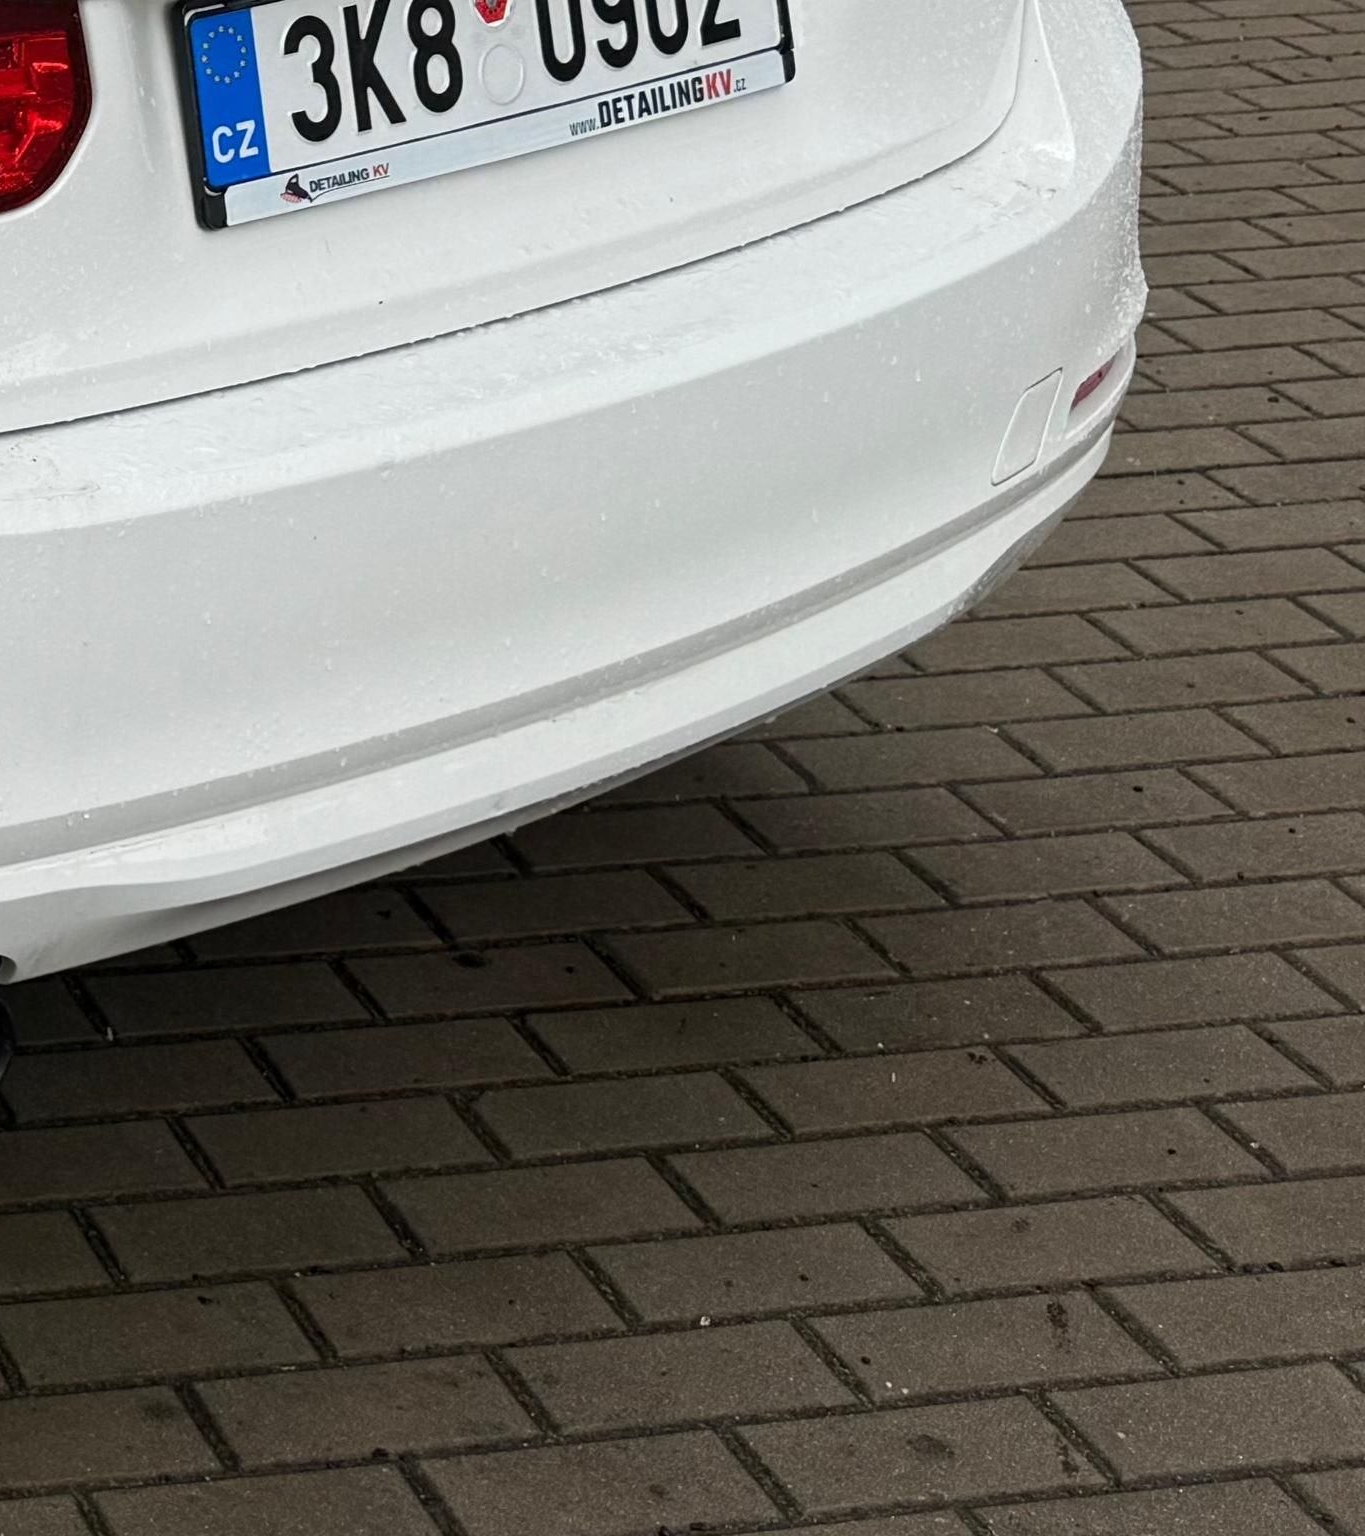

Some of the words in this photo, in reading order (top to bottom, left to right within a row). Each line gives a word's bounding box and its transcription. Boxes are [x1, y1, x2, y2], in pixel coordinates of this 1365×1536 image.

[212, 119, 259, 164] CZ
[309, 168, 369, 193] DETAILING
[372, 163, 390, 178] KV
